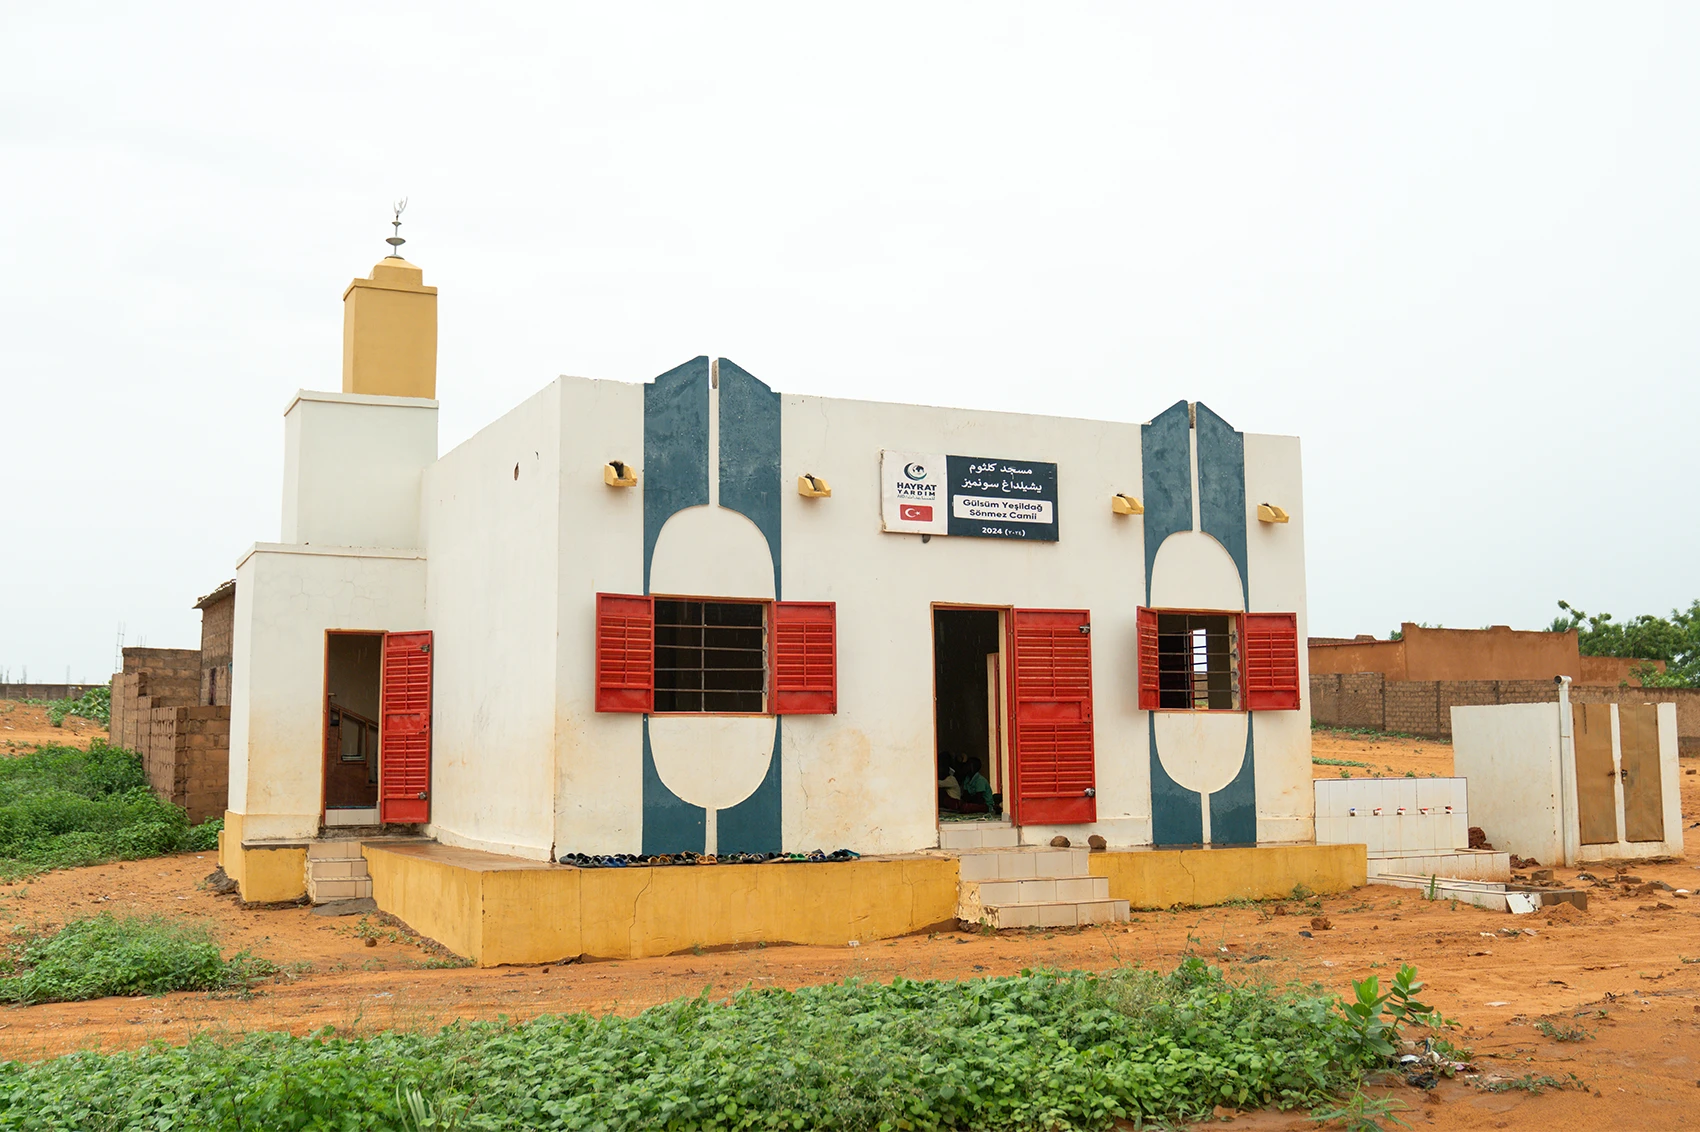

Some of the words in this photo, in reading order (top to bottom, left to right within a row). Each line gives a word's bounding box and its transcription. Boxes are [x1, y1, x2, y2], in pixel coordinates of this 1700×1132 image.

[969, 463, 997, 474] كلثوم
[1000, 465, 1033, 475] مسجد
[897, 482, 937, 491] HAYRAT
[963, 499, 999, 508] Gülsüm
[1002, 501, 1043, 512] Yeşildağ
[969, 509, 1007, 518] Sönmez
[1009, 512, 1037, 520] Camii
[981, 527, 1003, 535] 2024
